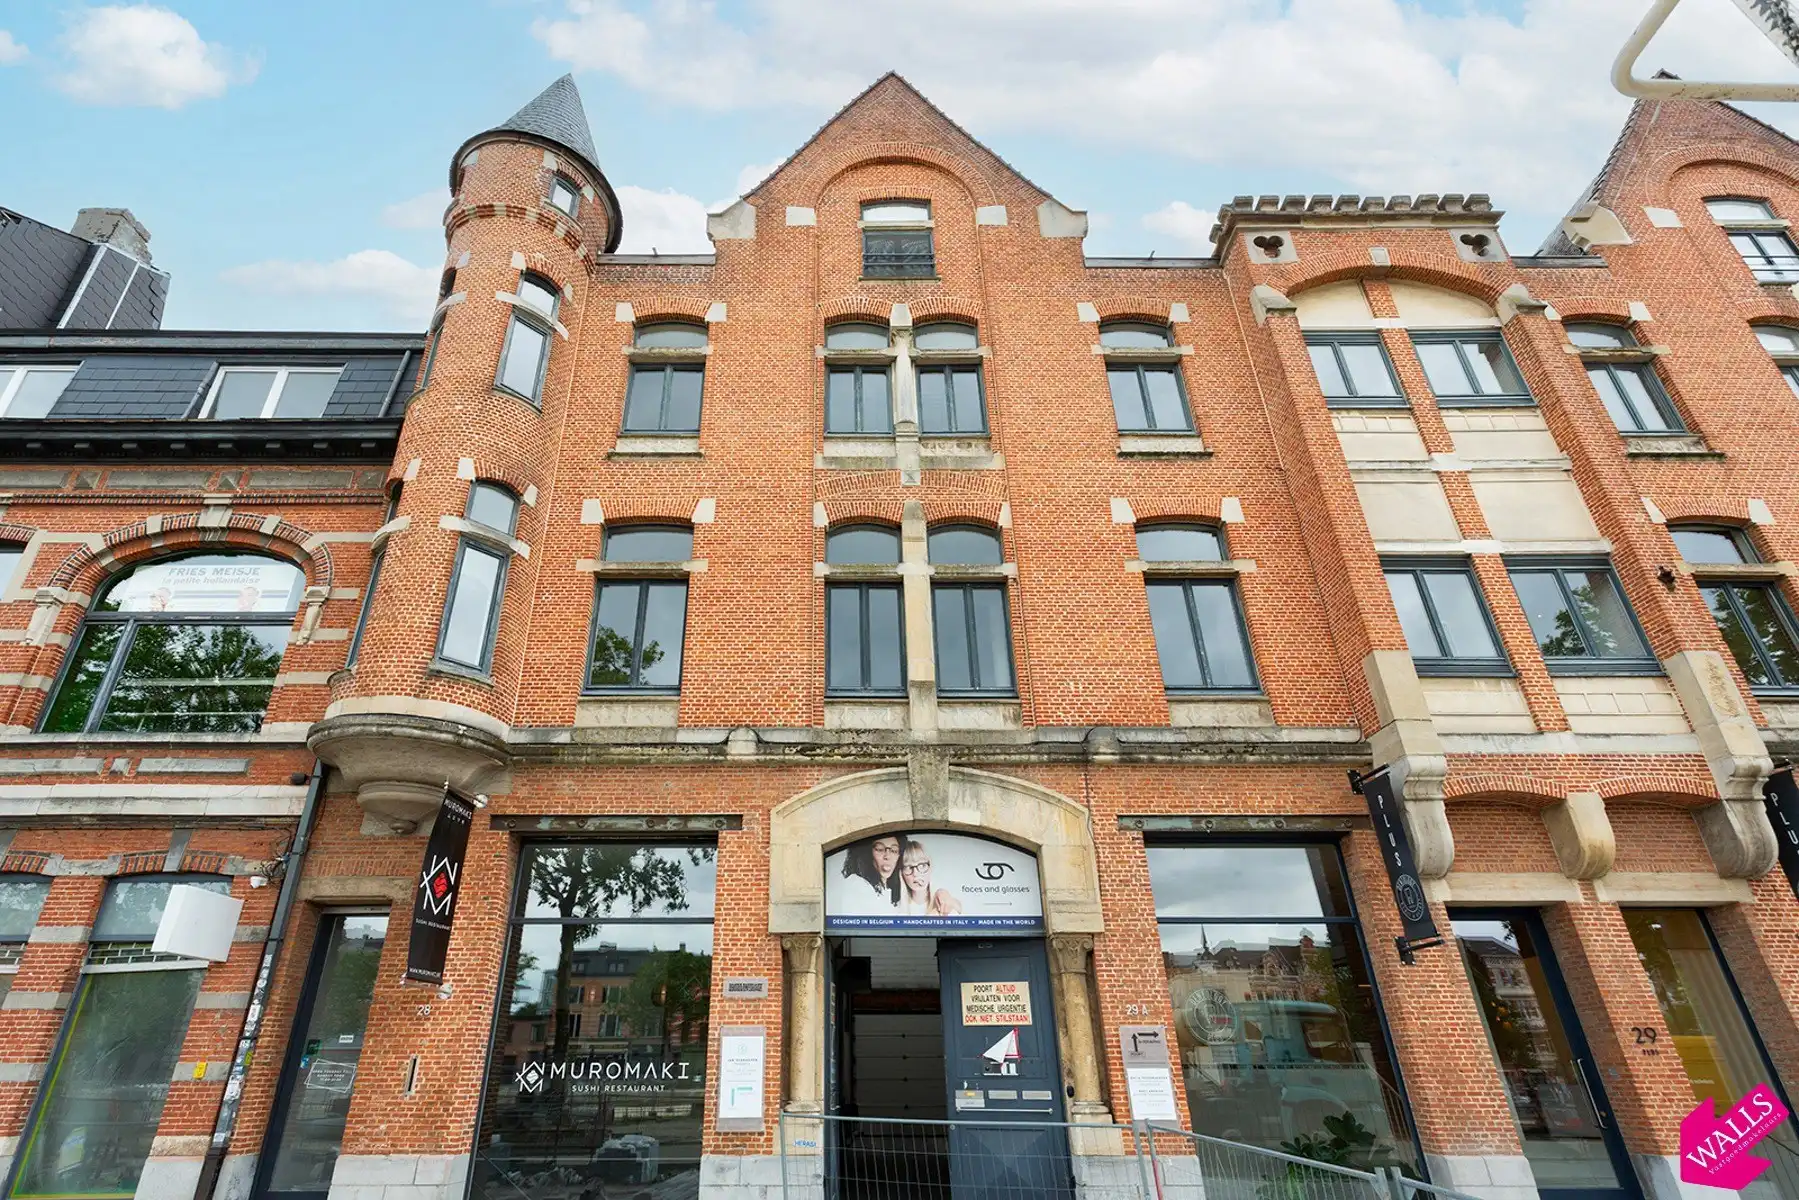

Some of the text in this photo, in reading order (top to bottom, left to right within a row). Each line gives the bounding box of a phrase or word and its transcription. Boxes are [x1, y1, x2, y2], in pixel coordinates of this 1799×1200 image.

[168, 567, 261, 576] FRIES MEISJE
[173, 577, 200, 585] petite
[1770, 792, 1799, 855] PLU
[1377, 794, 1402, 867] PLUS
[961, 885, 1030, 894] faces and glasses
[973, 985, 993, 993] POORT
[417, 1004, 431, 1016] 28
[966, 1004, 1027, 1013] MEDISCHE URGENTIE
[1126, 1004, 1149, 1016] 29 A
[965, 1015, 978, 1023] OOK
[1632, 1027, 1657, 1044] 29
[550, 1062, 690, 1080] MUROMAKI
[571, 1084, 665, 1092] SUSHI RESTAURANT
